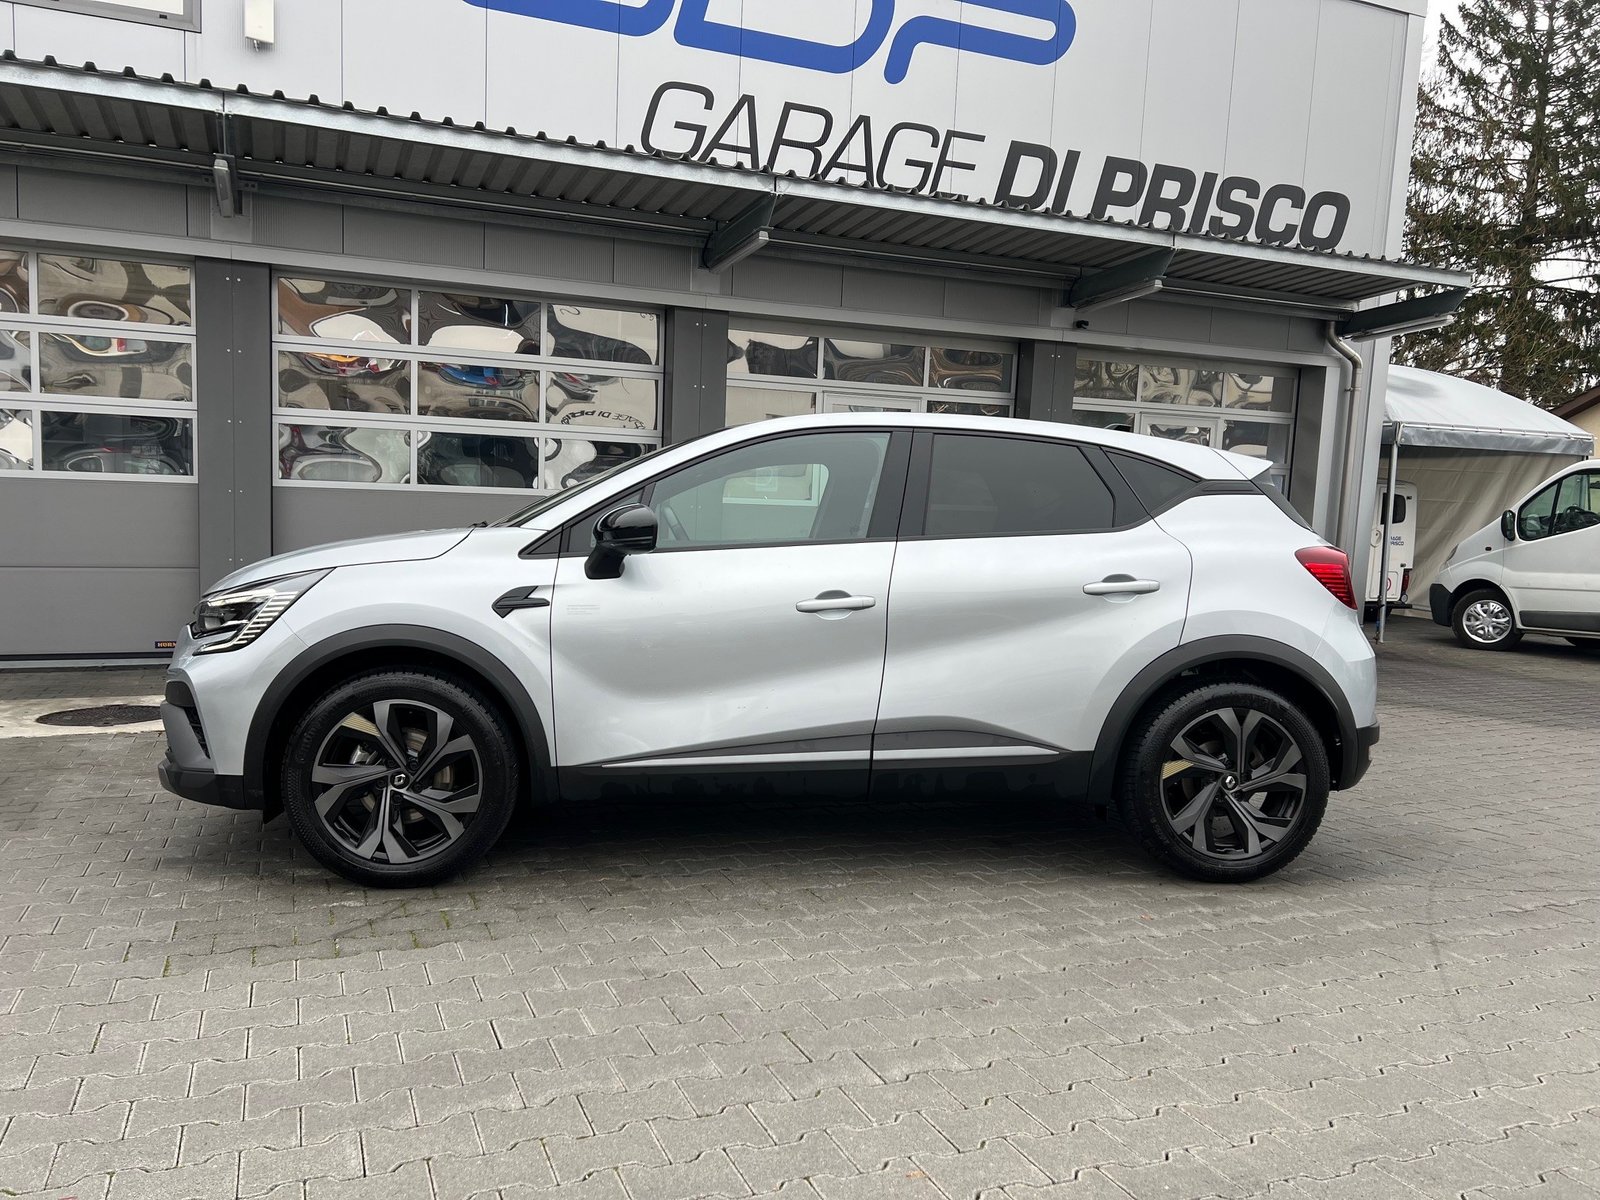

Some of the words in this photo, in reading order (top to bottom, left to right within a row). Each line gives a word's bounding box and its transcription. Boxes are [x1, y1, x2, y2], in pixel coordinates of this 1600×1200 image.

[641, 81, 986, 199] GARAGE
[993, 140, 1081, 215] DI
[1091, 155, 1351, 249] PRISCO
